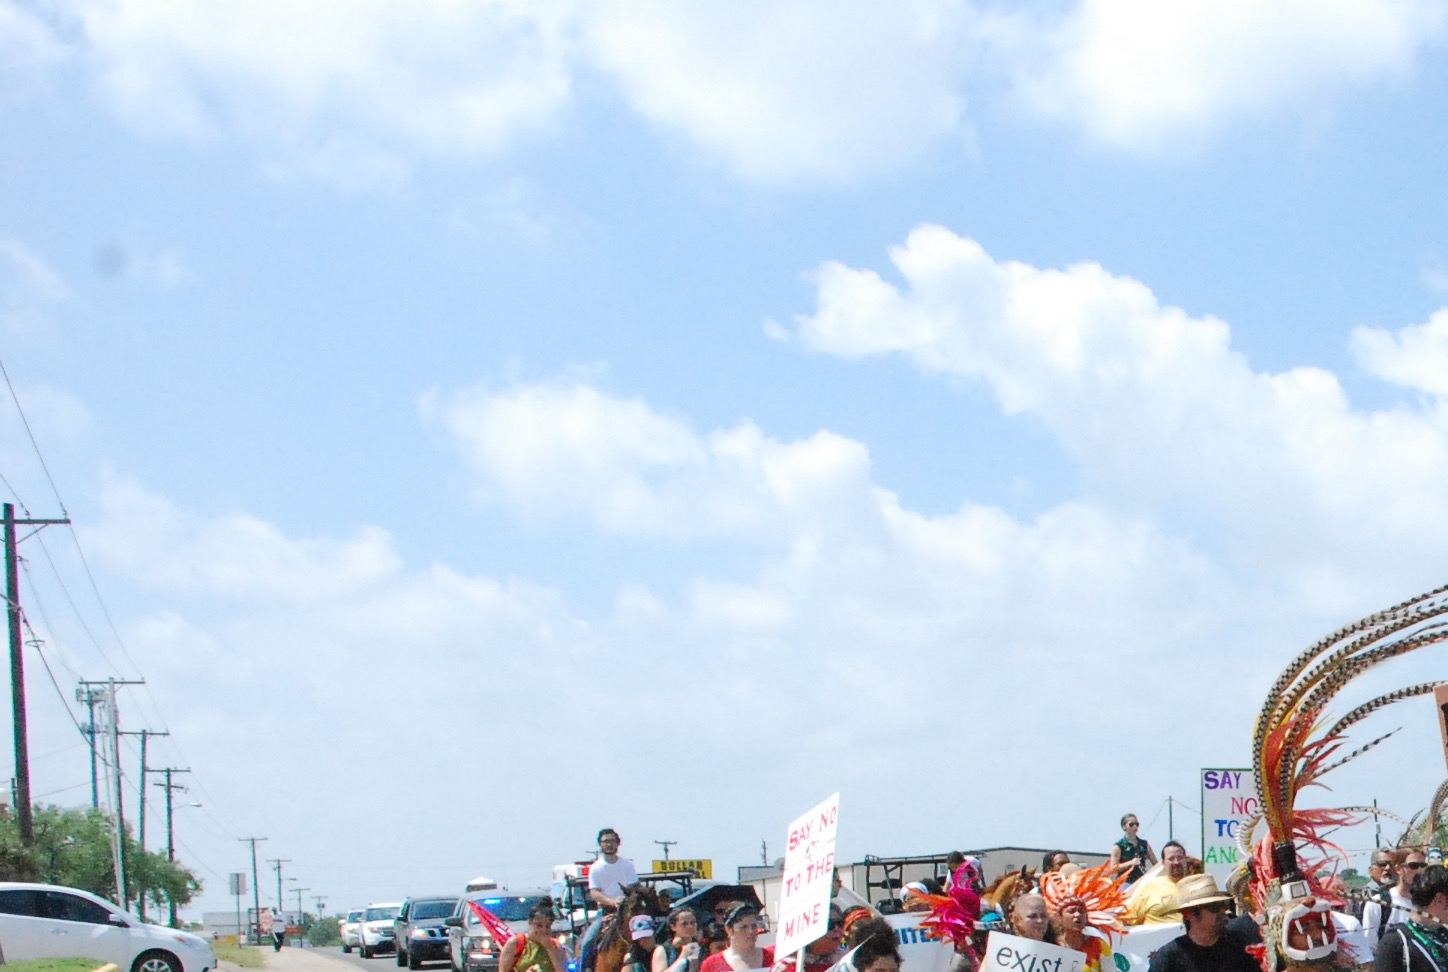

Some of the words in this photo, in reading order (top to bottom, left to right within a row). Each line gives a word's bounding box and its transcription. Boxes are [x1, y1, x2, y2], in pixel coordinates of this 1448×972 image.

[1204, 771, 1241, 789] SAY
[1231, 797, 1258, 814] NO
[789, 818, 813, 851] SAY
[819, 806, 837, 832] NO
[661, 861, 703, 871] DOLLAR
[786, 873, 801, 897] TO
[807, 852, 834, 885] THE
[784, 903, 821, 940] MINE
